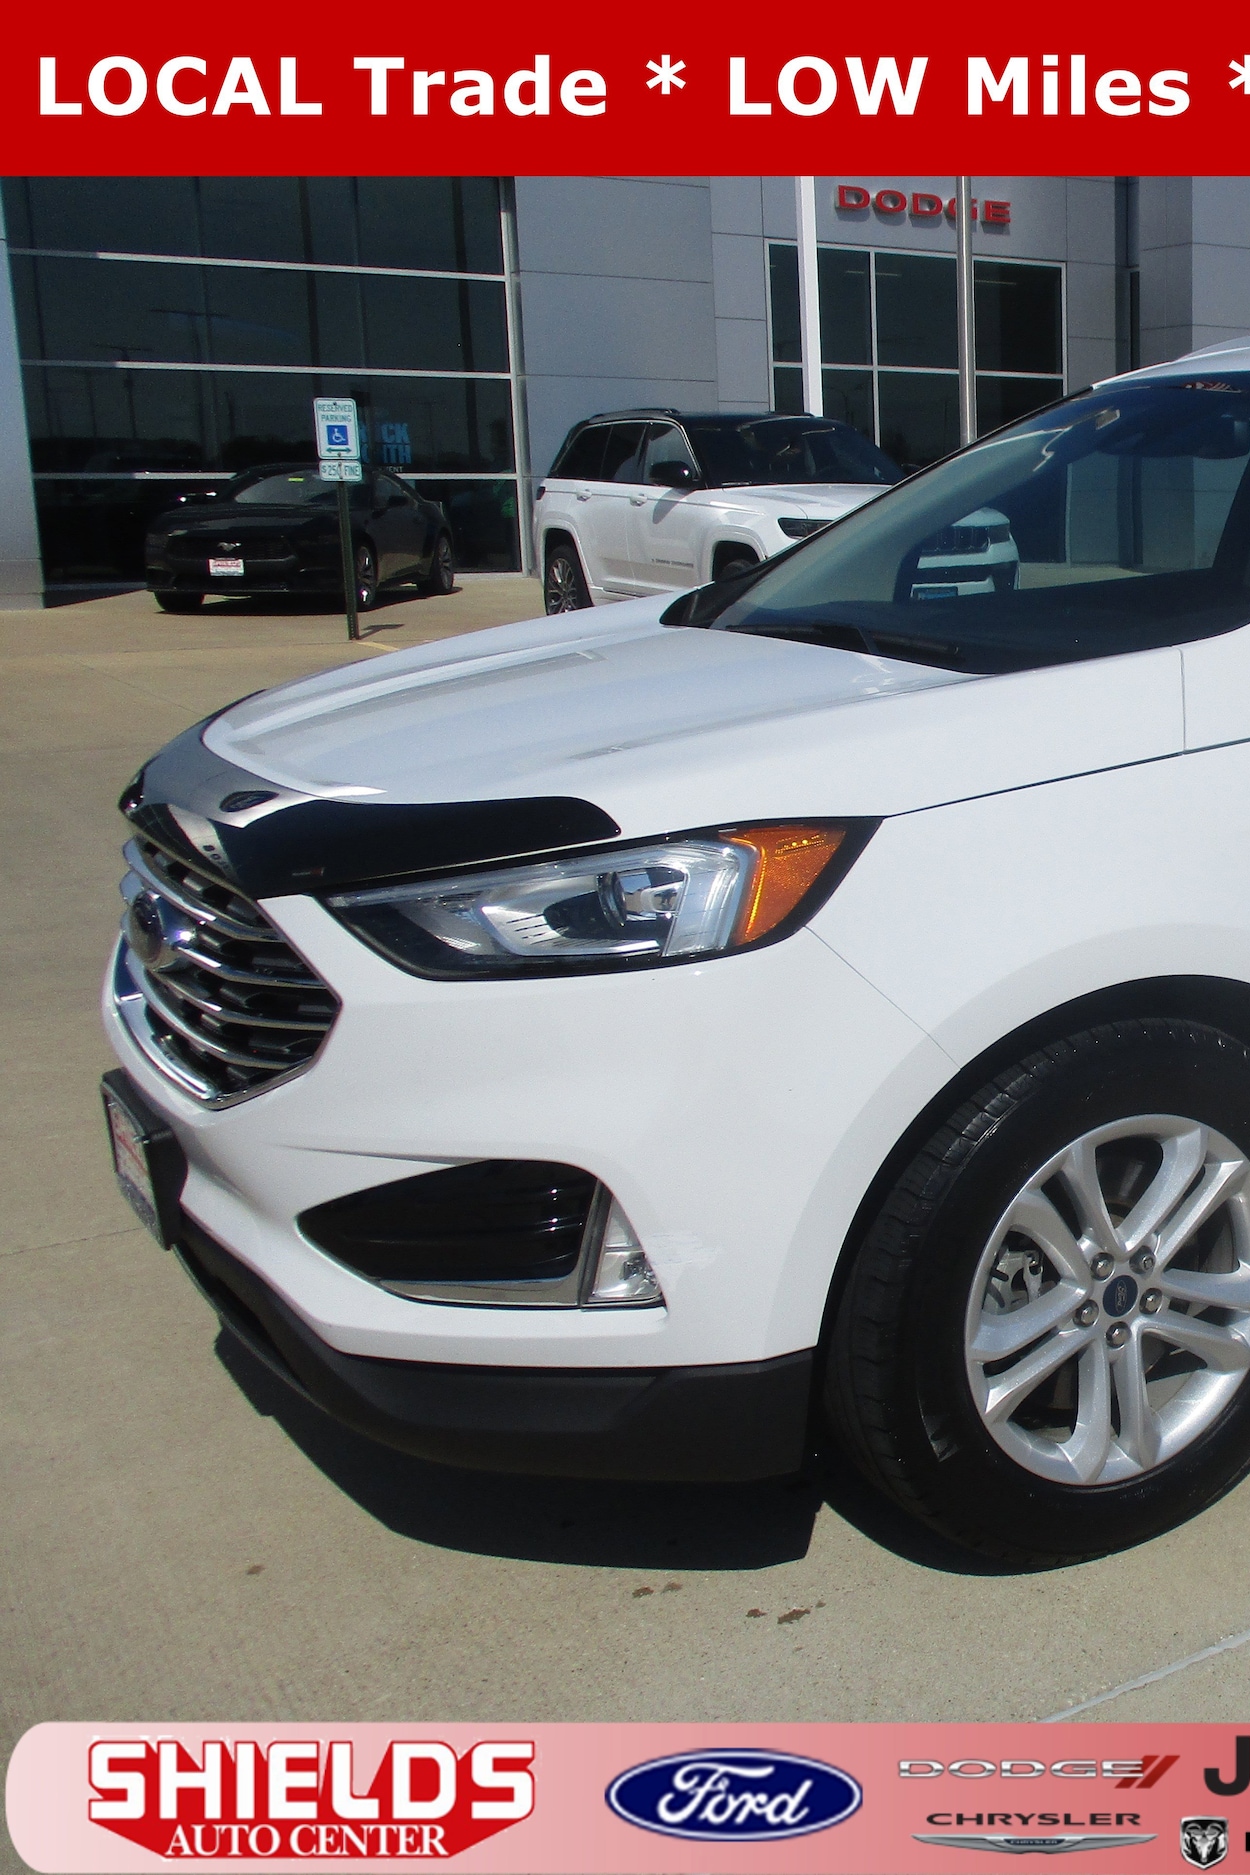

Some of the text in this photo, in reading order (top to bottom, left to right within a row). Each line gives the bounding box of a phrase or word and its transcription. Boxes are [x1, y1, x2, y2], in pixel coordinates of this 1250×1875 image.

[836, 185, 1011, 223] DODGE
[317, 404, 353, 413] RESERVED
[321, 414, 352, 423] PARKING
[344, 465, 360, 476] FINE
